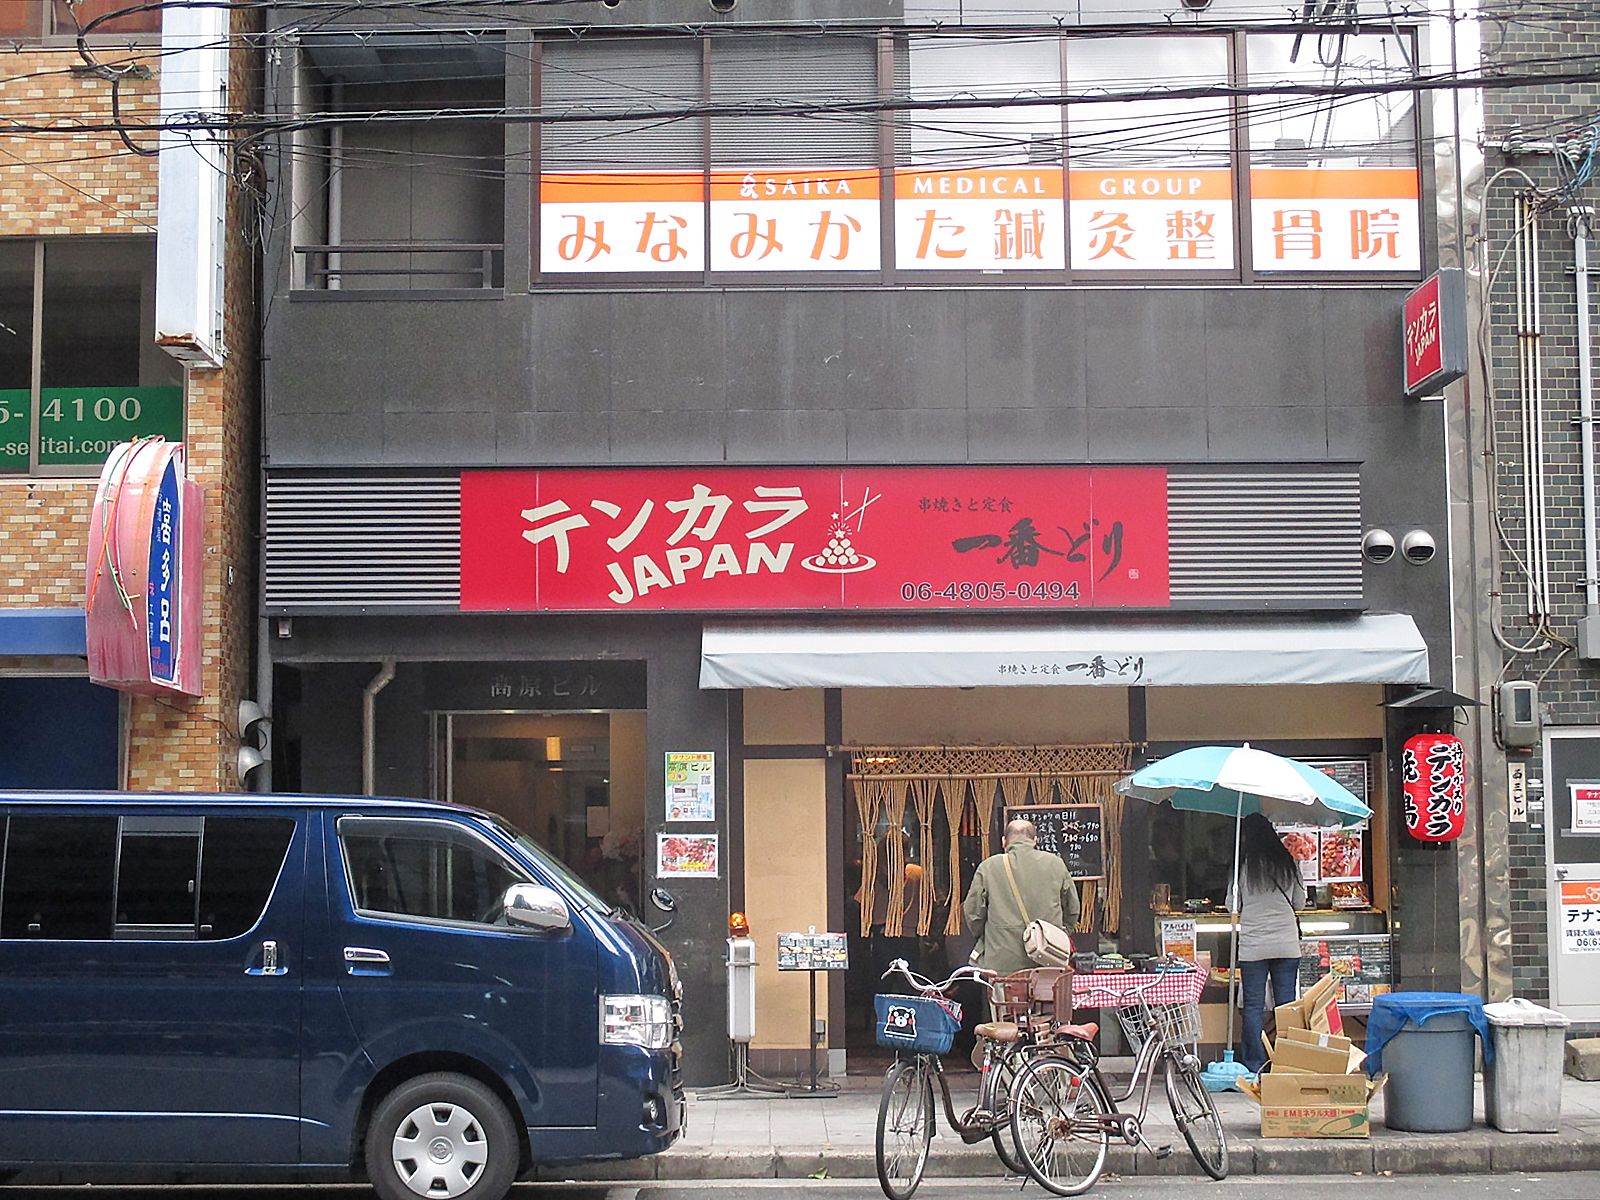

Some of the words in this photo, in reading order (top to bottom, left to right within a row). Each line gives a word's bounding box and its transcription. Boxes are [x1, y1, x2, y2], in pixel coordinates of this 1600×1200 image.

[765, 177, 851, 196] SAIKA
[913, 177, 1047, 194] MEDICAL
[1099, 178, 1203, 195] GROUP
[558, 208, 1402, 264] みなみかた鍼灸整骨院
[1407, 301, 1437, 356] テンカラ
[1415, 327, 1436, 367] JAPAN
[918, 497, 1014, 513] 串焼きと定食
[520, 483, 809, 574] テンカラ
[952, 517, 1123, 583] 一番どり
[606, 542, 795, 604] JAPAN
[901, 582, 1080, 601] 06-4805-0494
[491, 674, 601, 698] 高原ビル
[997, 663, 1061, 676] 串焼きと定食
[1065, 655, 1144, 684] 一番どり
[1425, 744, 1453, 837] テンカラ
[1567, 909, 1600, 923] テナ
